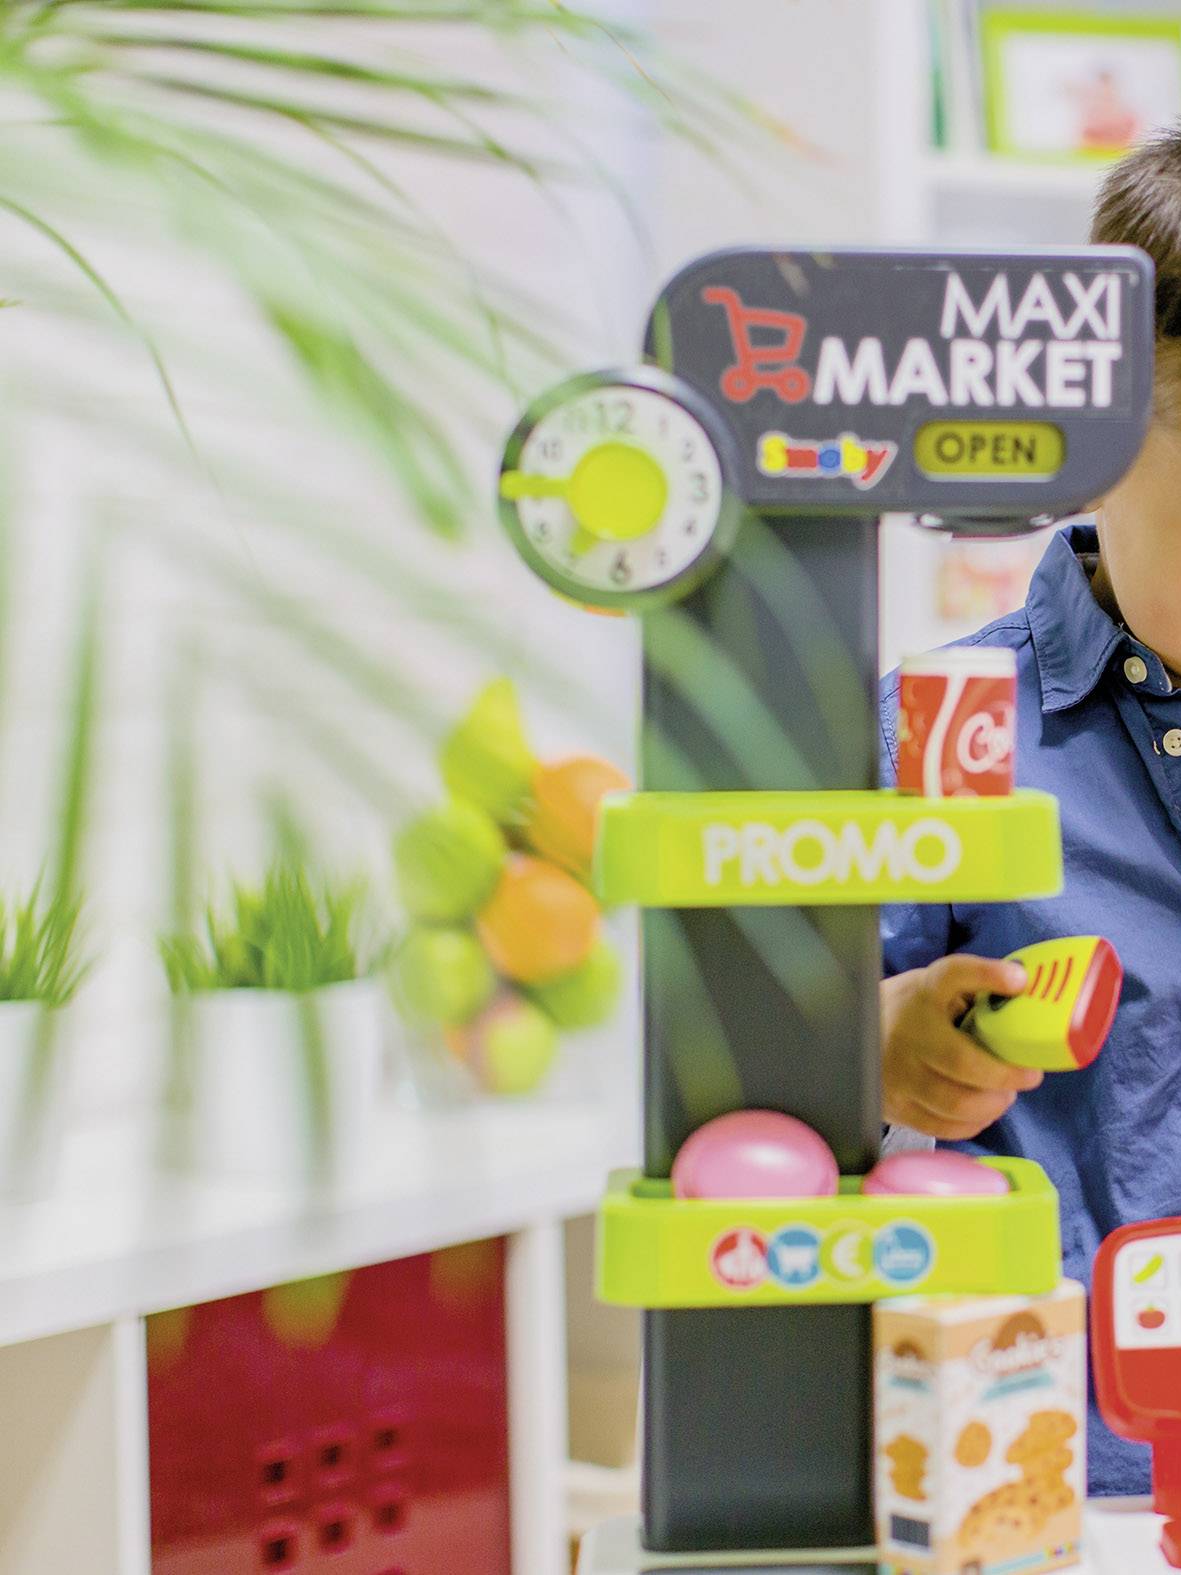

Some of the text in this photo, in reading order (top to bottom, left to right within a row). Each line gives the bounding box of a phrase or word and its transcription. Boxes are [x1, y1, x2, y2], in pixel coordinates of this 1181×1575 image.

[940, 271, 1121, 340] MAXI
[813, 335, 1123, 408] MARKET
[934, 430, 1037, 465] OPEN
[689, 470, 711, 505] 3
[608, 548, 634, 585] 6
[702, 817, 962, 886] PROMO
